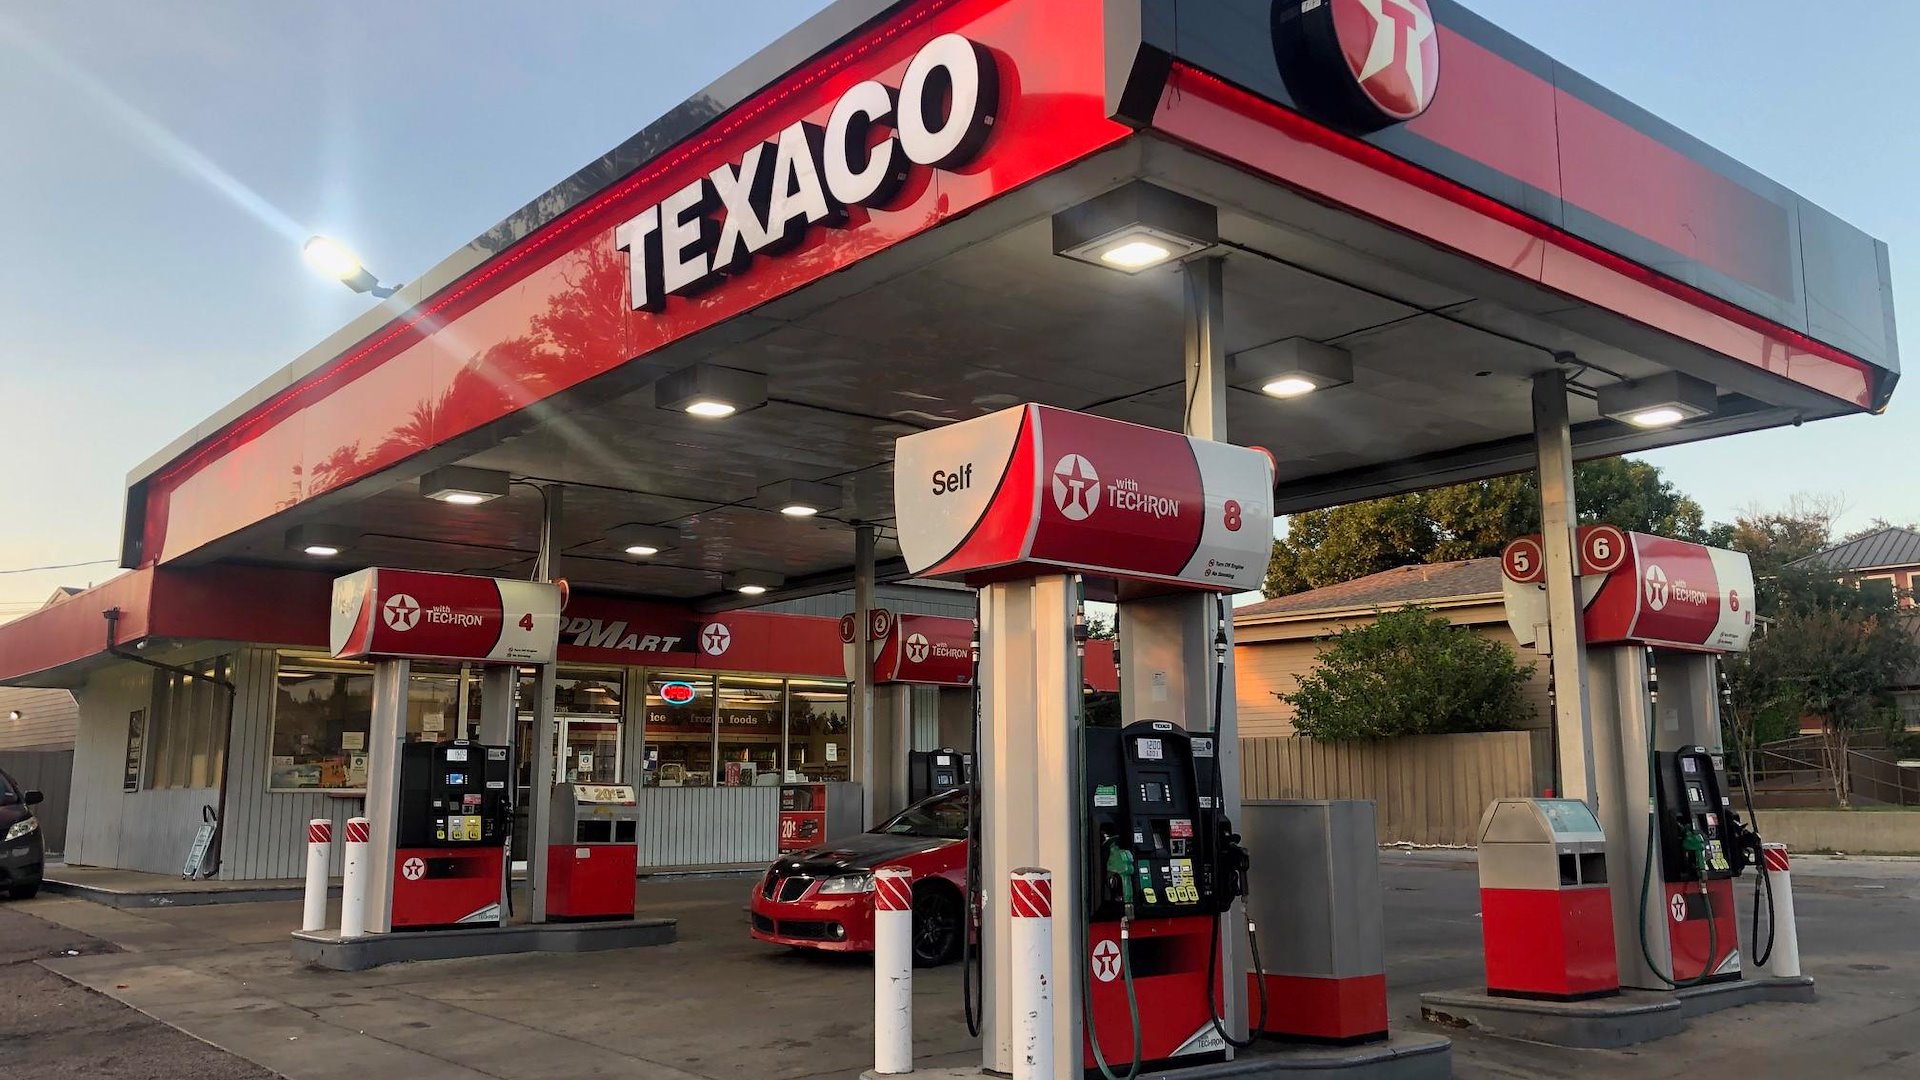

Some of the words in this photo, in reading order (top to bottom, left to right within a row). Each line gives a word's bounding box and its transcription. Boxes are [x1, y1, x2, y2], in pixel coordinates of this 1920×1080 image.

[615, 32, 981, 311] TEXACO
[932, 462, 974, 496] Self
[1115, 478, 1139, 492] with
[1107, 485, 1180, 519] TECHRON
[1223, 500, 1242, 532] 8
[1593, 537, 1610, 560] 6
[1513, 550, 1530, 573] 5
[1671, 584, 1708, 606] TECHRON
[1729, 589, 1740, 612] 6
[432, 605, 451, 613] with
[426, 610, 483, 628] TECHRON
[518, 613, 534, 632] 4
[842, 621, 849, 635] 1
[876, 617, 884, 630] 2
[932, 645, 968, 660] TECHRON
[664, 686, 692, 700] OPEN
[650, 712, 667, 723] ice
[690, 714, 726, 726] frozn
[728, 714, 759, 726] foods
